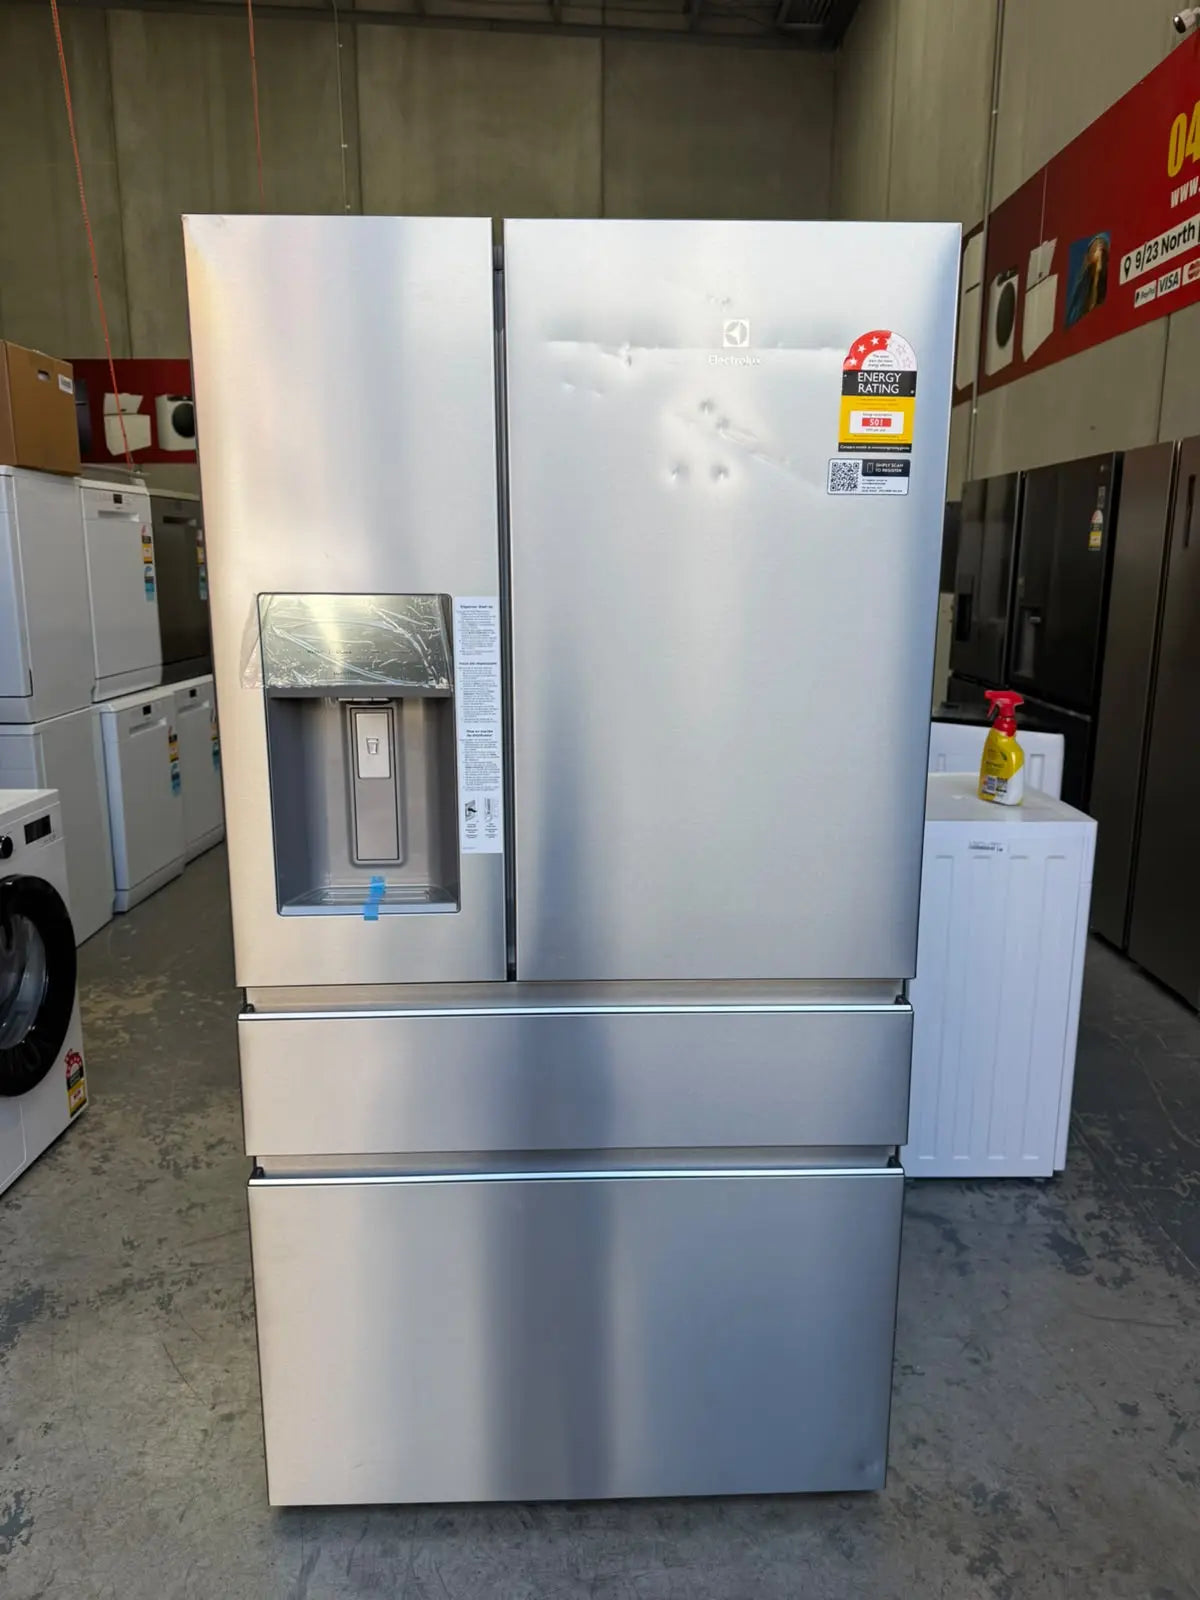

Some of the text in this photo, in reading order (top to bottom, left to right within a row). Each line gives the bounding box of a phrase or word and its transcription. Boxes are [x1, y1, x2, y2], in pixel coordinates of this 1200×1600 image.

[1135, 221, 1195, 272] 9/23 North
[1159, 271, 1179, 293] VISA
[857, 372, 902, 383] ENERGY
[857, 383, 900, 394] RATING
